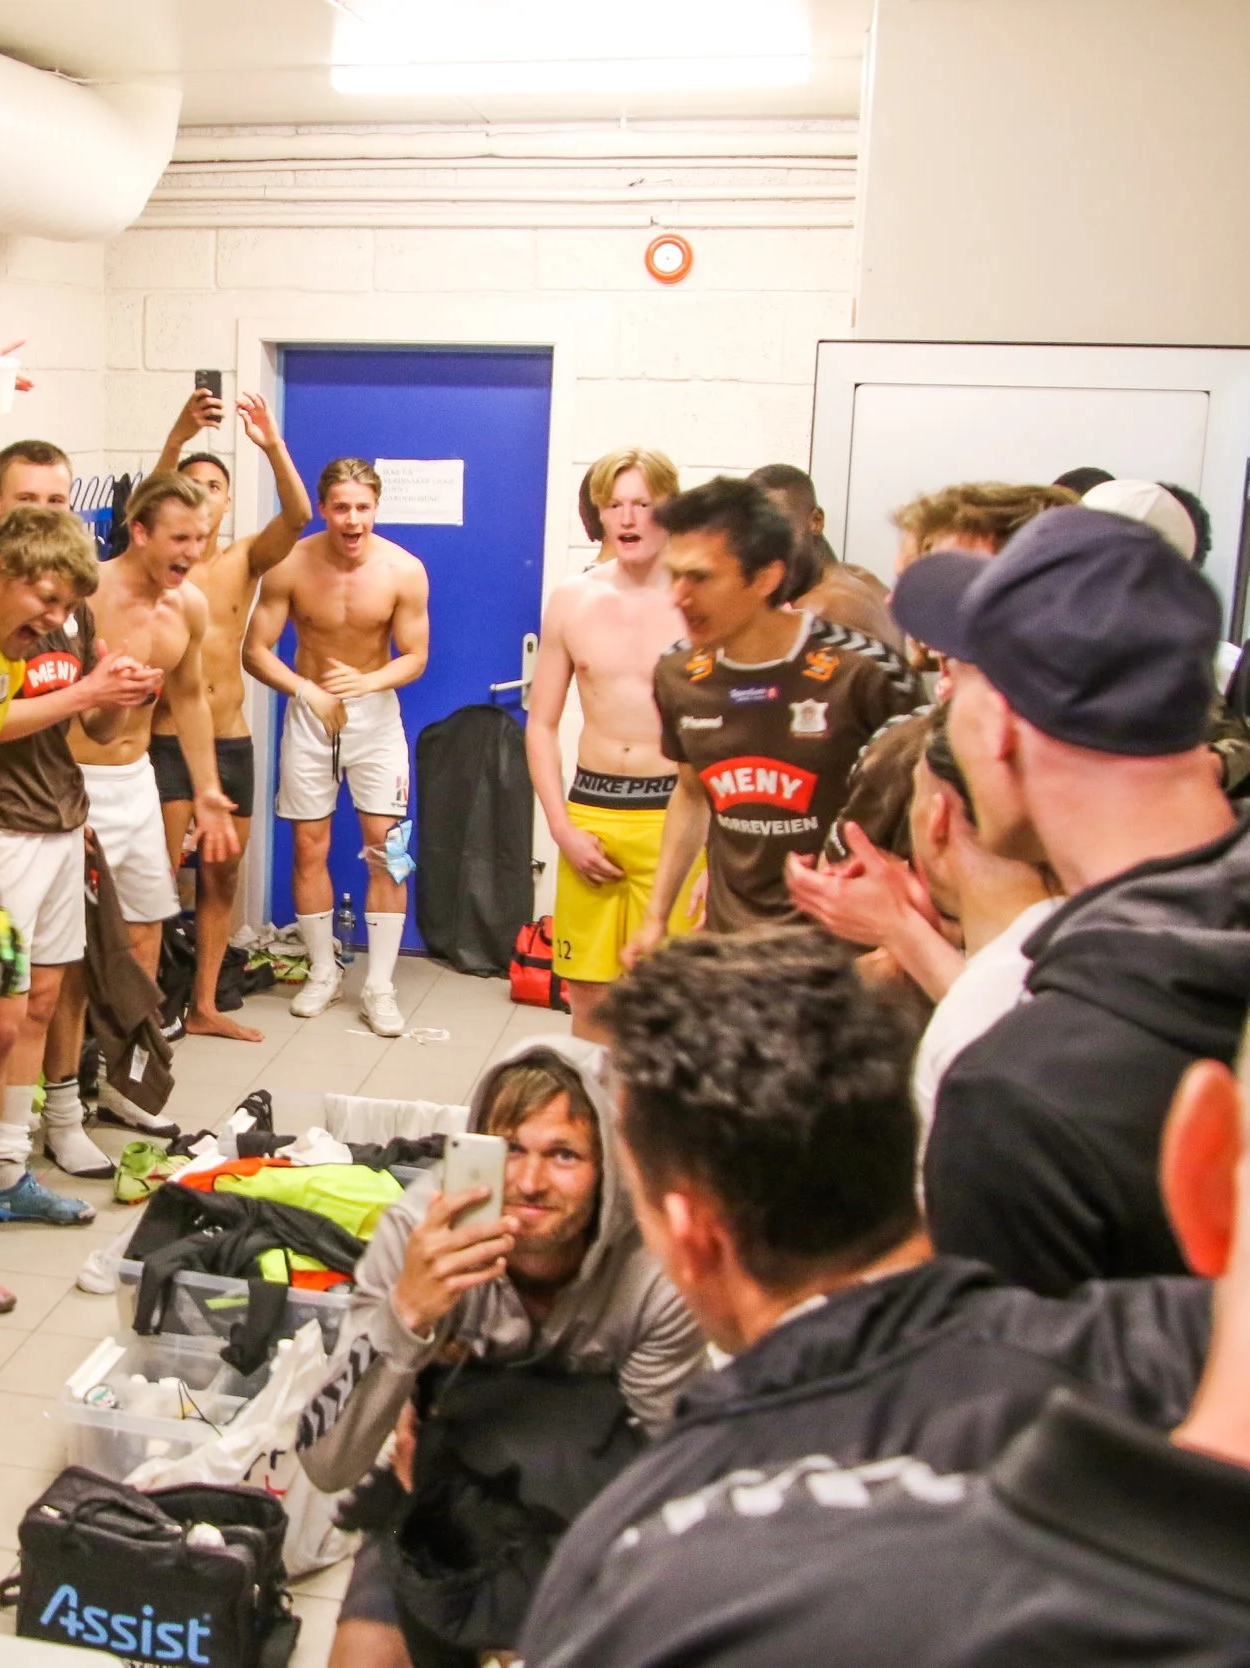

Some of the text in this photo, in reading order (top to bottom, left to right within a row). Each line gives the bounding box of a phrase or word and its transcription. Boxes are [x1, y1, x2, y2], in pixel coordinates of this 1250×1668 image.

[27, 660, 78, 689] MENY
[578, 775, 623, 794] NIKE
[710, 767, 803, 800] MENY
[39, 1583, 211, 1665] Assist
